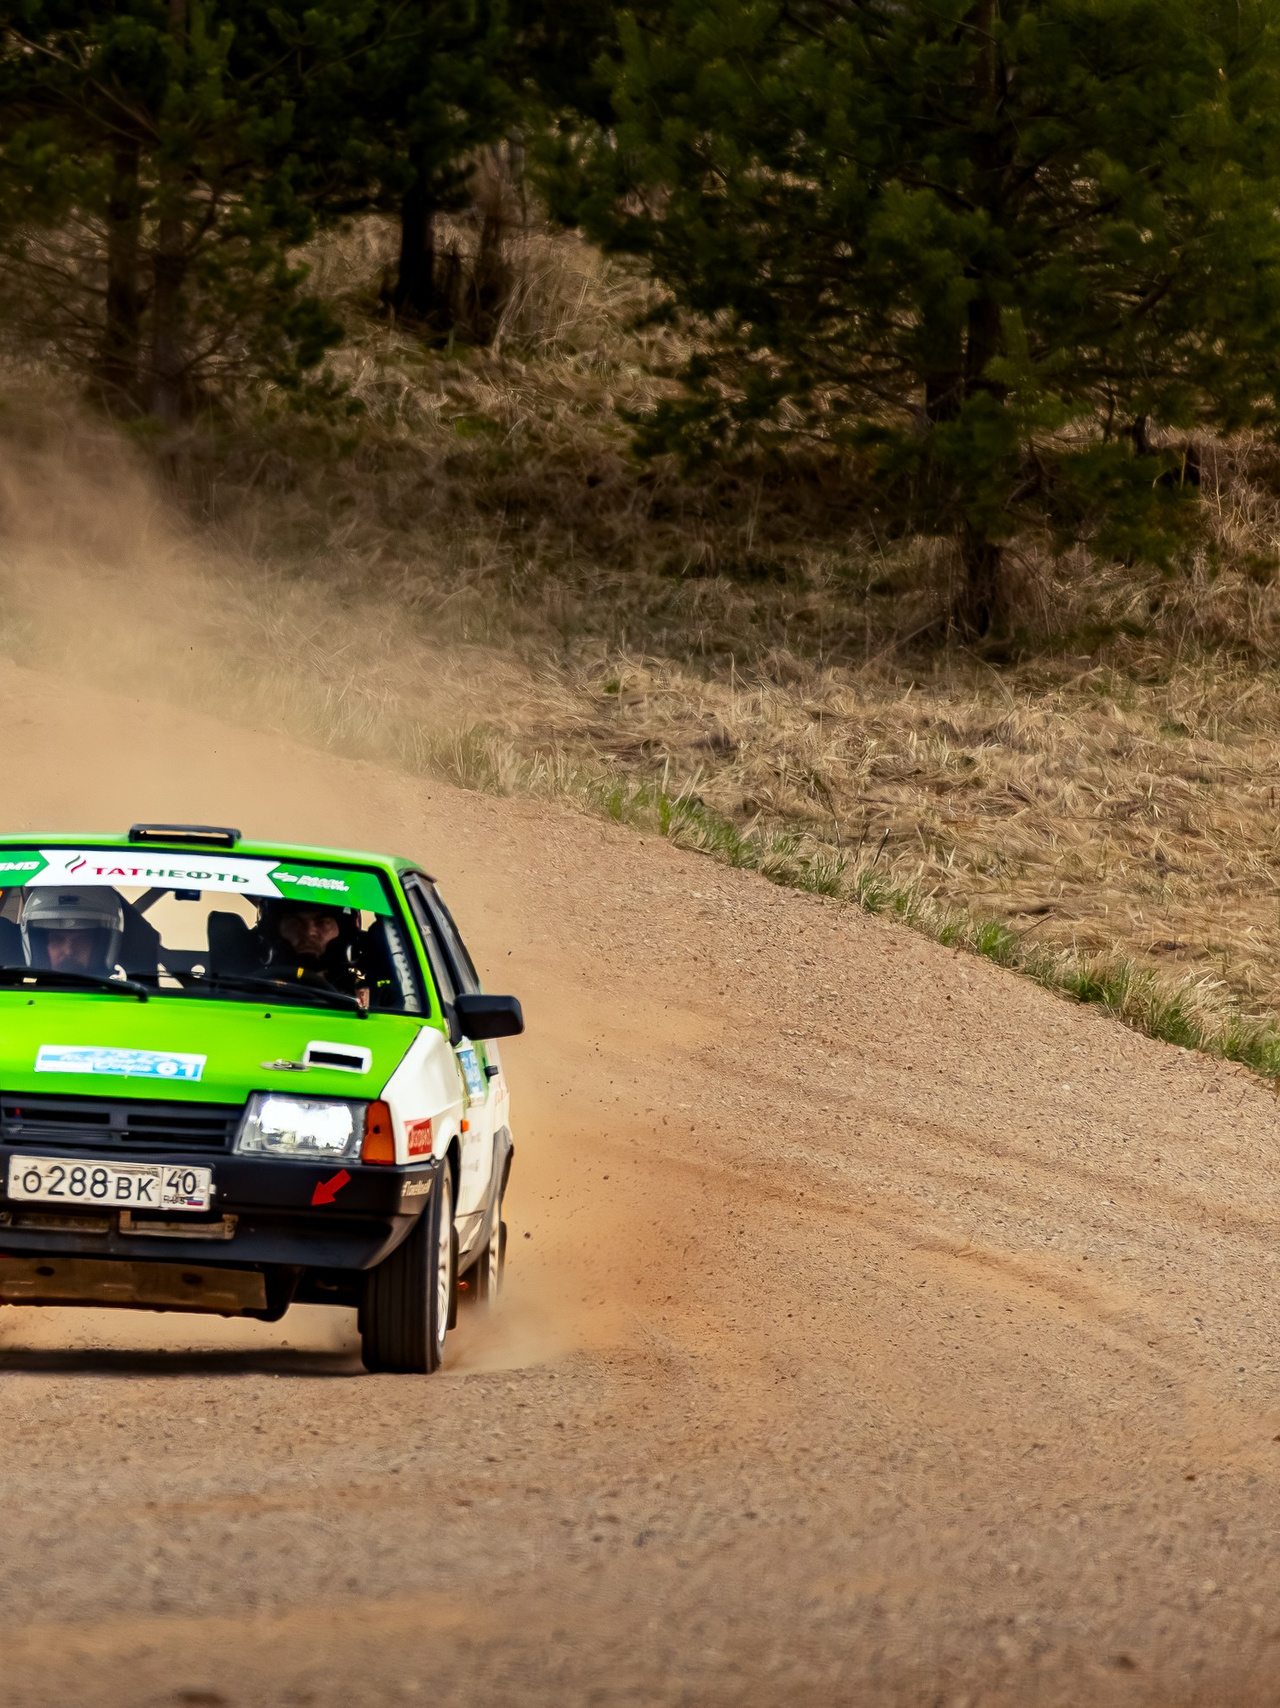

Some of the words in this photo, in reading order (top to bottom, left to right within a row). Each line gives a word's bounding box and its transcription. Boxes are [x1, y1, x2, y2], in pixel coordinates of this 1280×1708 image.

[92, 867, 250, 883] ТАТНЕФТЬ
[156, 1061, 195, 1077] 61
[167, 1170, 197, 1195] 40
